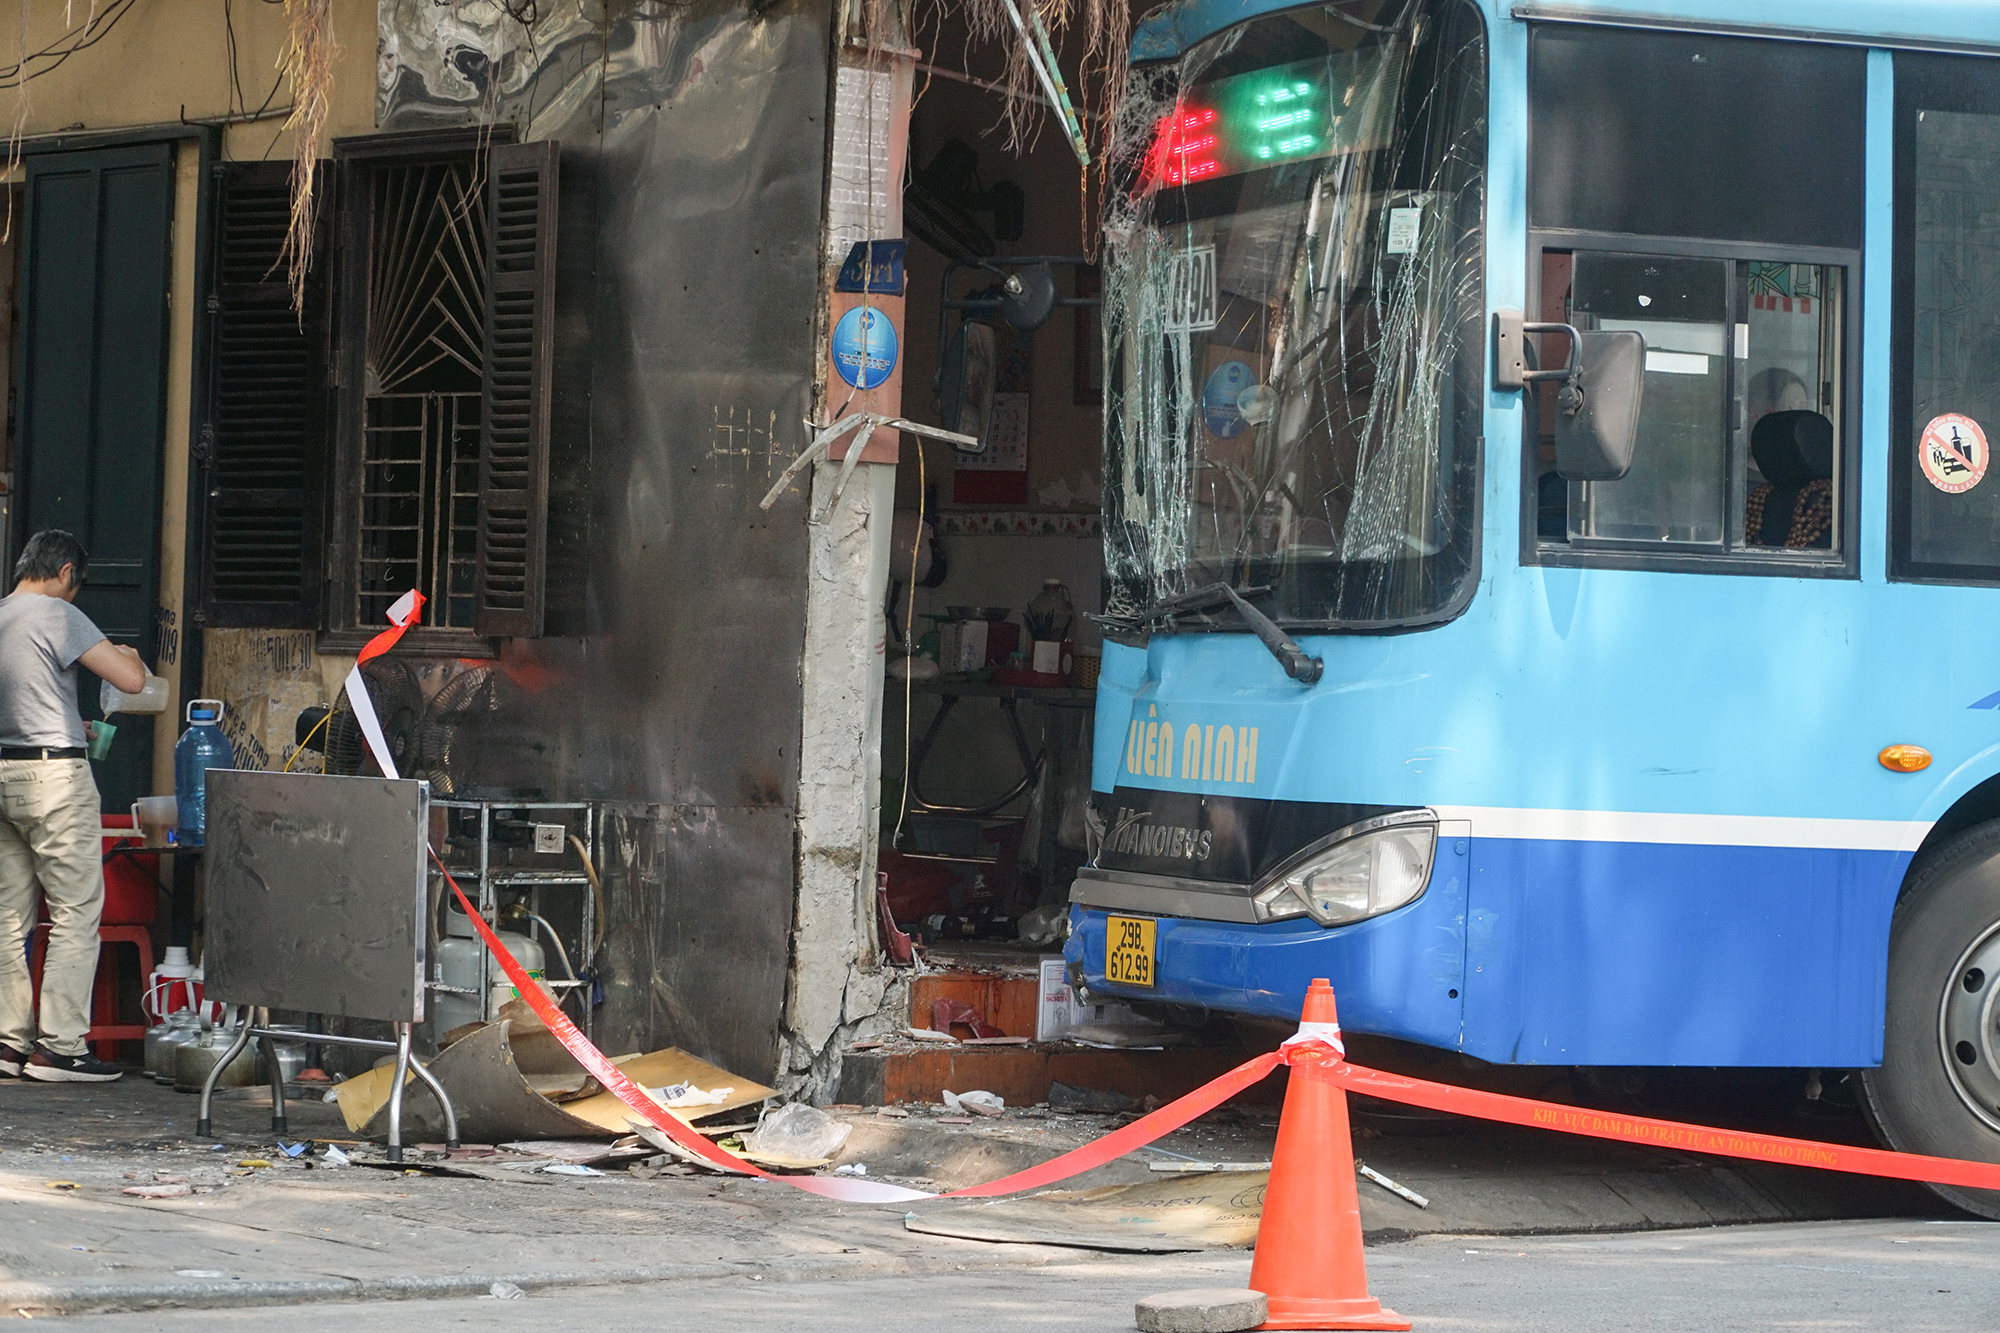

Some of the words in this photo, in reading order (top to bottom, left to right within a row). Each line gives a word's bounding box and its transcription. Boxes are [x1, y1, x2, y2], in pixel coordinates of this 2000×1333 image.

[1933, 477, 1959, 491] KHÔNG
[1974, 470, 1983, 480] XE
[158, 606, 176, 626] ong
[1127, 704, 1174, 778] LIÊN
[1181, 723, 1259, 784] NINH
[1104, 807, 1212, 861] HANOIBUS
[1120, 921, 1142, 950] 29B
[1111, 952, 1149, 982] 612.99
[1533, 1108, 1562, 1125] KHU
[1564, 1113, 1591, 1131] VỰC
[1707, 1136, 1726, 1149] AN
[1762, 1142, 1793, 1159] GIAO
[1795, 1146, 1838, 1166] THÔNG
[1120, 1195, 1212, 1208] OREST
